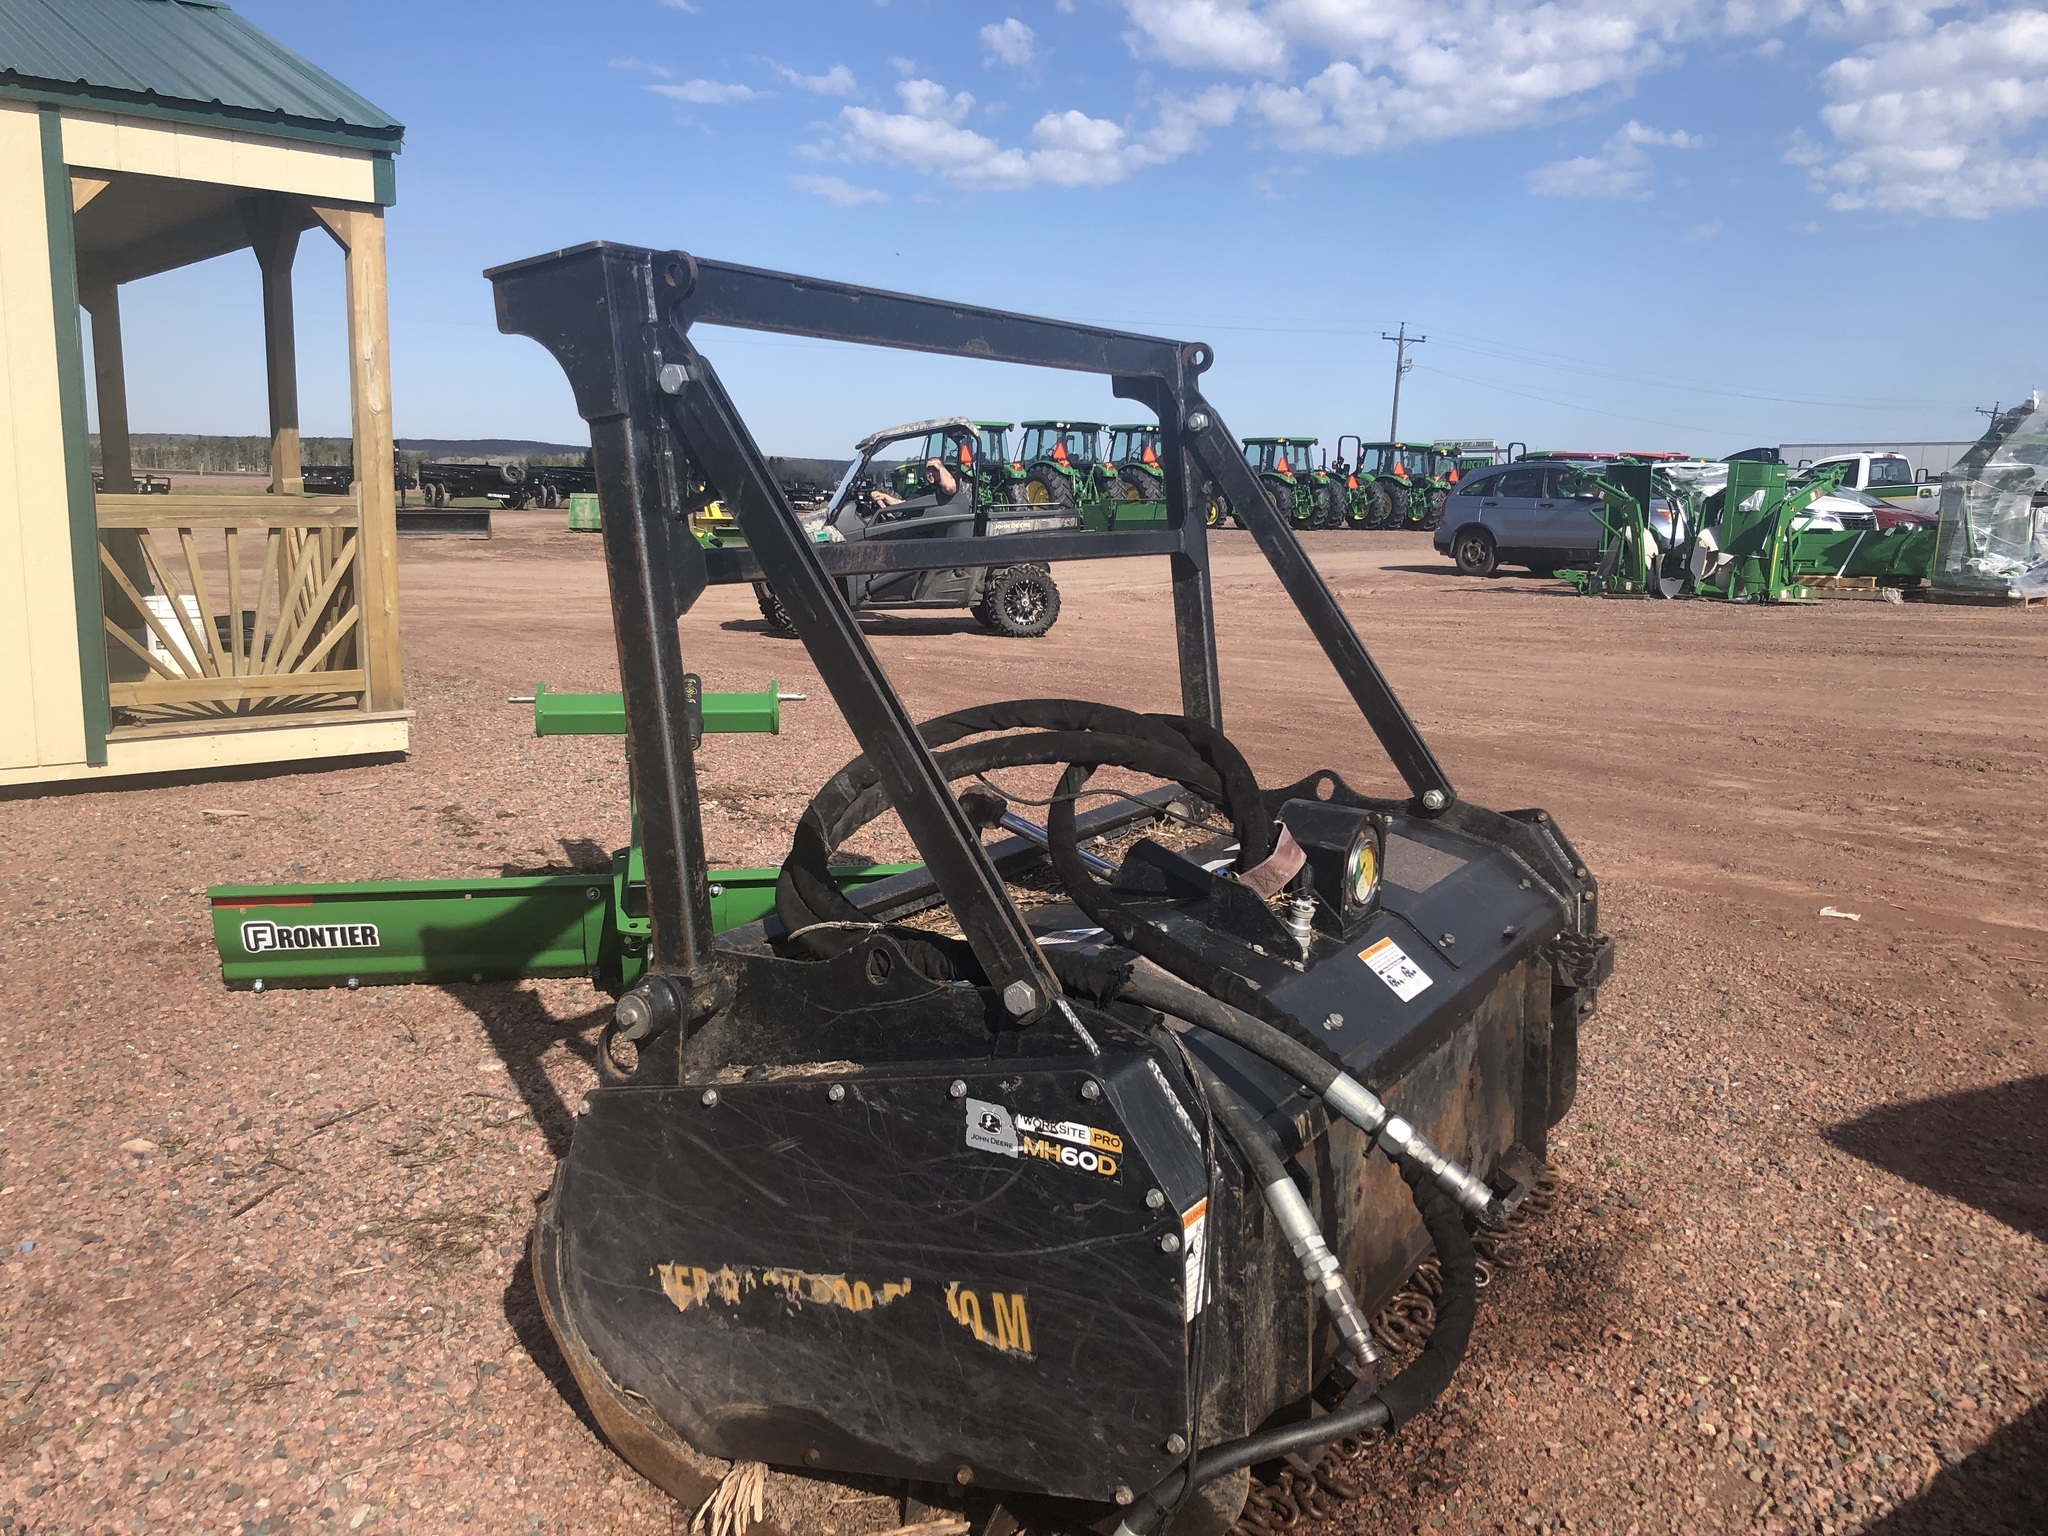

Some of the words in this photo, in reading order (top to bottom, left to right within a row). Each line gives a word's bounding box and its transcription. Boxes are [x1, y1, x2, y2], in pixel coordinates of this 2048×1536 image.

[243, 922, 378, 952] FRONTIER
[971, 1132, 990, 1143] JOHN
[990, 1136, 1014, 1149] DEERE
[1093, 1132, 1121, 1148] PRO
[1023, 1136, 1118, 1176] MH60D
